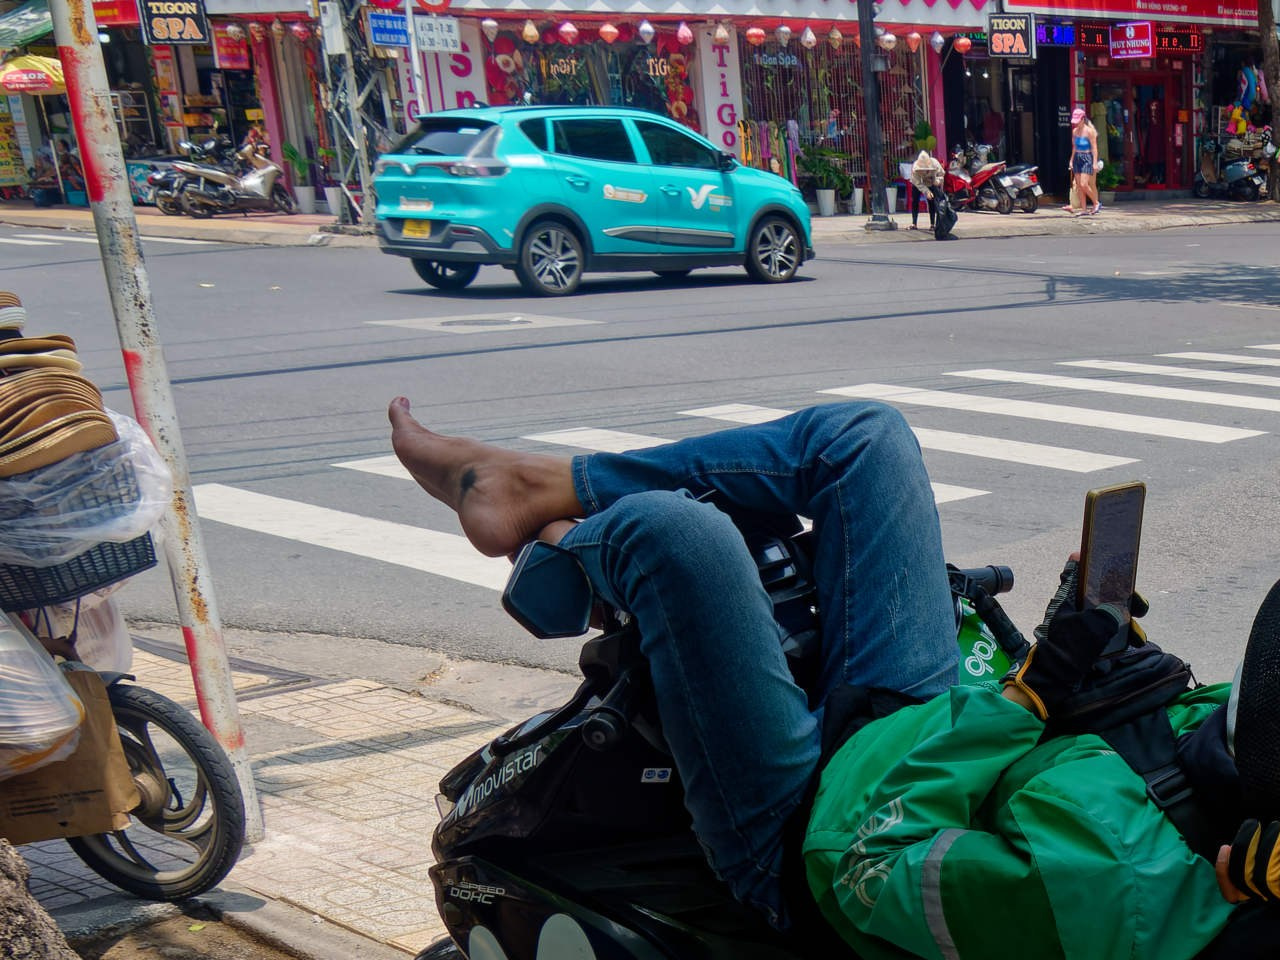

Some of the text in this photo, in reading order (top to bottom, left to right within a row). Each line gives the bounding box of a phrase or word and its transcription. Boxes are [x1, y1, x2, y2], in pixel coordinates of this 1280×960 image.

[148, 2, 198, 15] TIGON
[152, 17, 203, 40] SPA
[991, 18, 1026, 30] TIGON
[991, 32, 1028, 54] SPA
[711, 44, 737, 160] TiGo
[474, 744, 543, 804] movistar
[450, 886, 497, 905] DOHC
